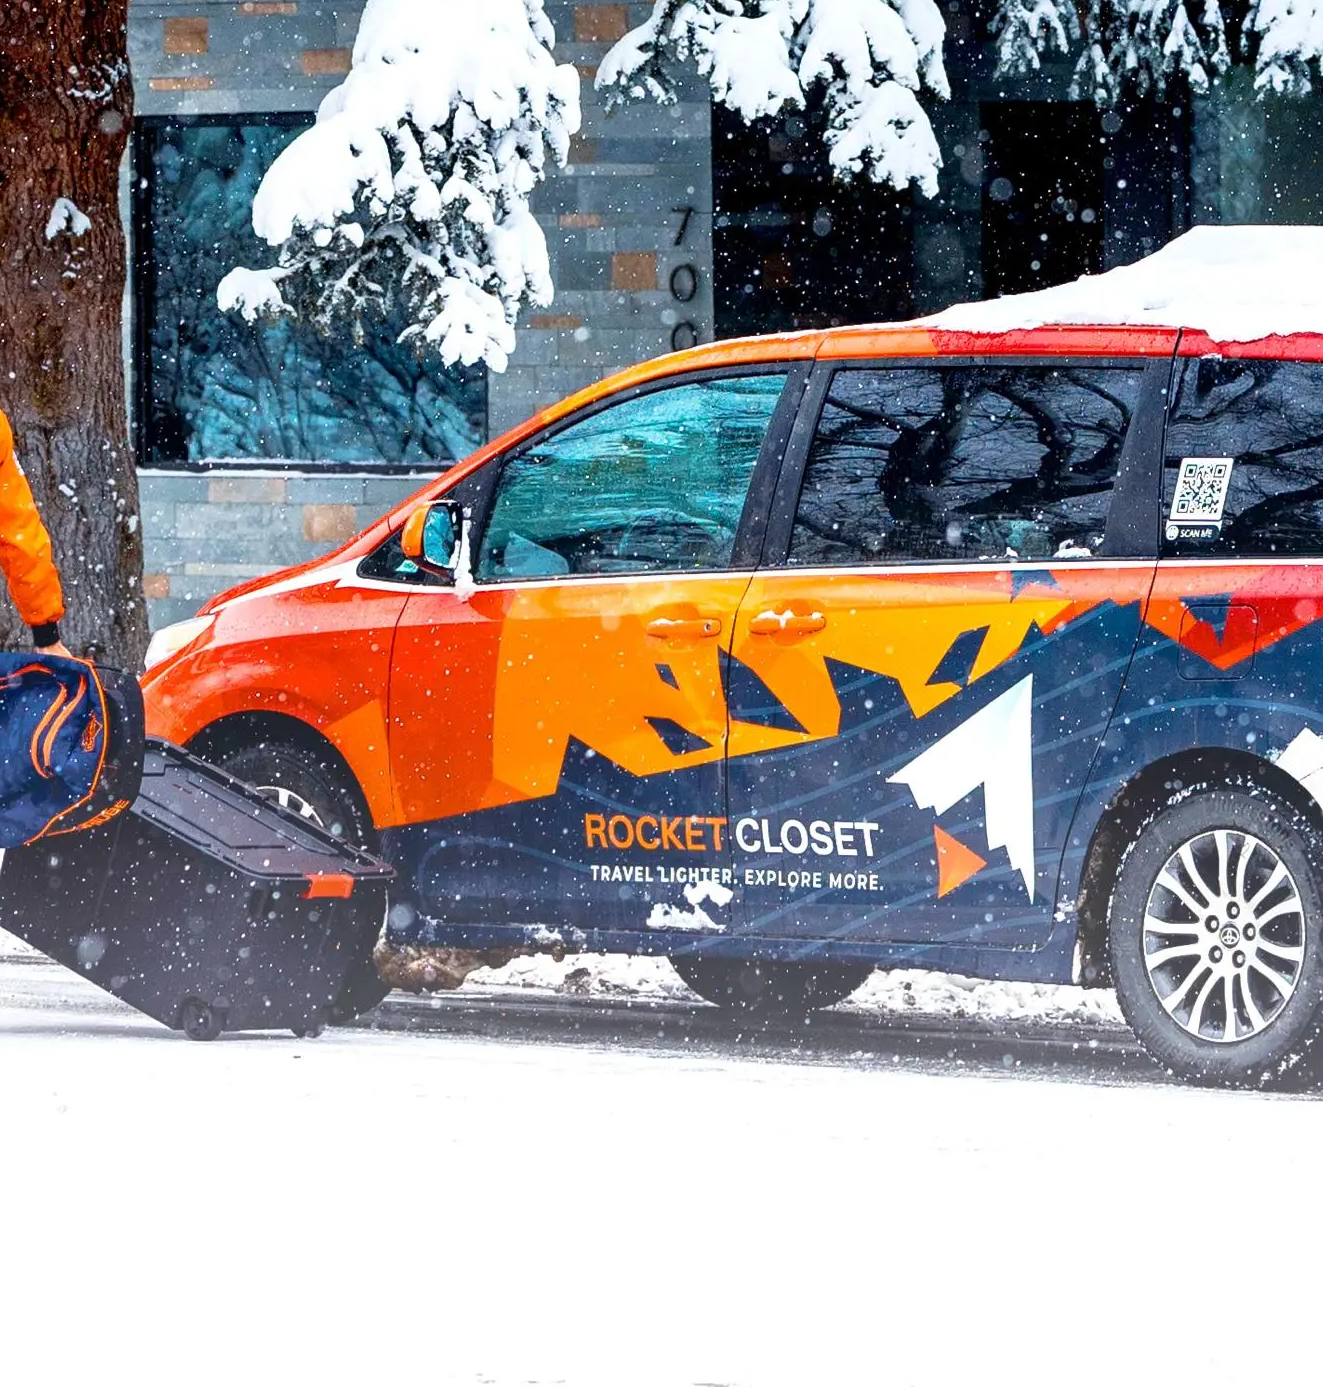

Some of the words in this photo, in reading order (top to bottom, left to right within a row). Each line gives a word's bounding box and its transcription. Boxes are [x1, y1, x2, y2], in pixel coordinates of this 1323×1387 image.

[1180, 529, 1201, 538] SCAN
[585, 813, 727, 851] ROCKET
[735, 817, 879, 857] CLOSET
[590, 865, 654, 882] TRAVEL
[656, 865, 738, 884] LIGHTER.
[744, 868, 822, 888] EXPLORE
[829, 872, 884, 891] MORE.
